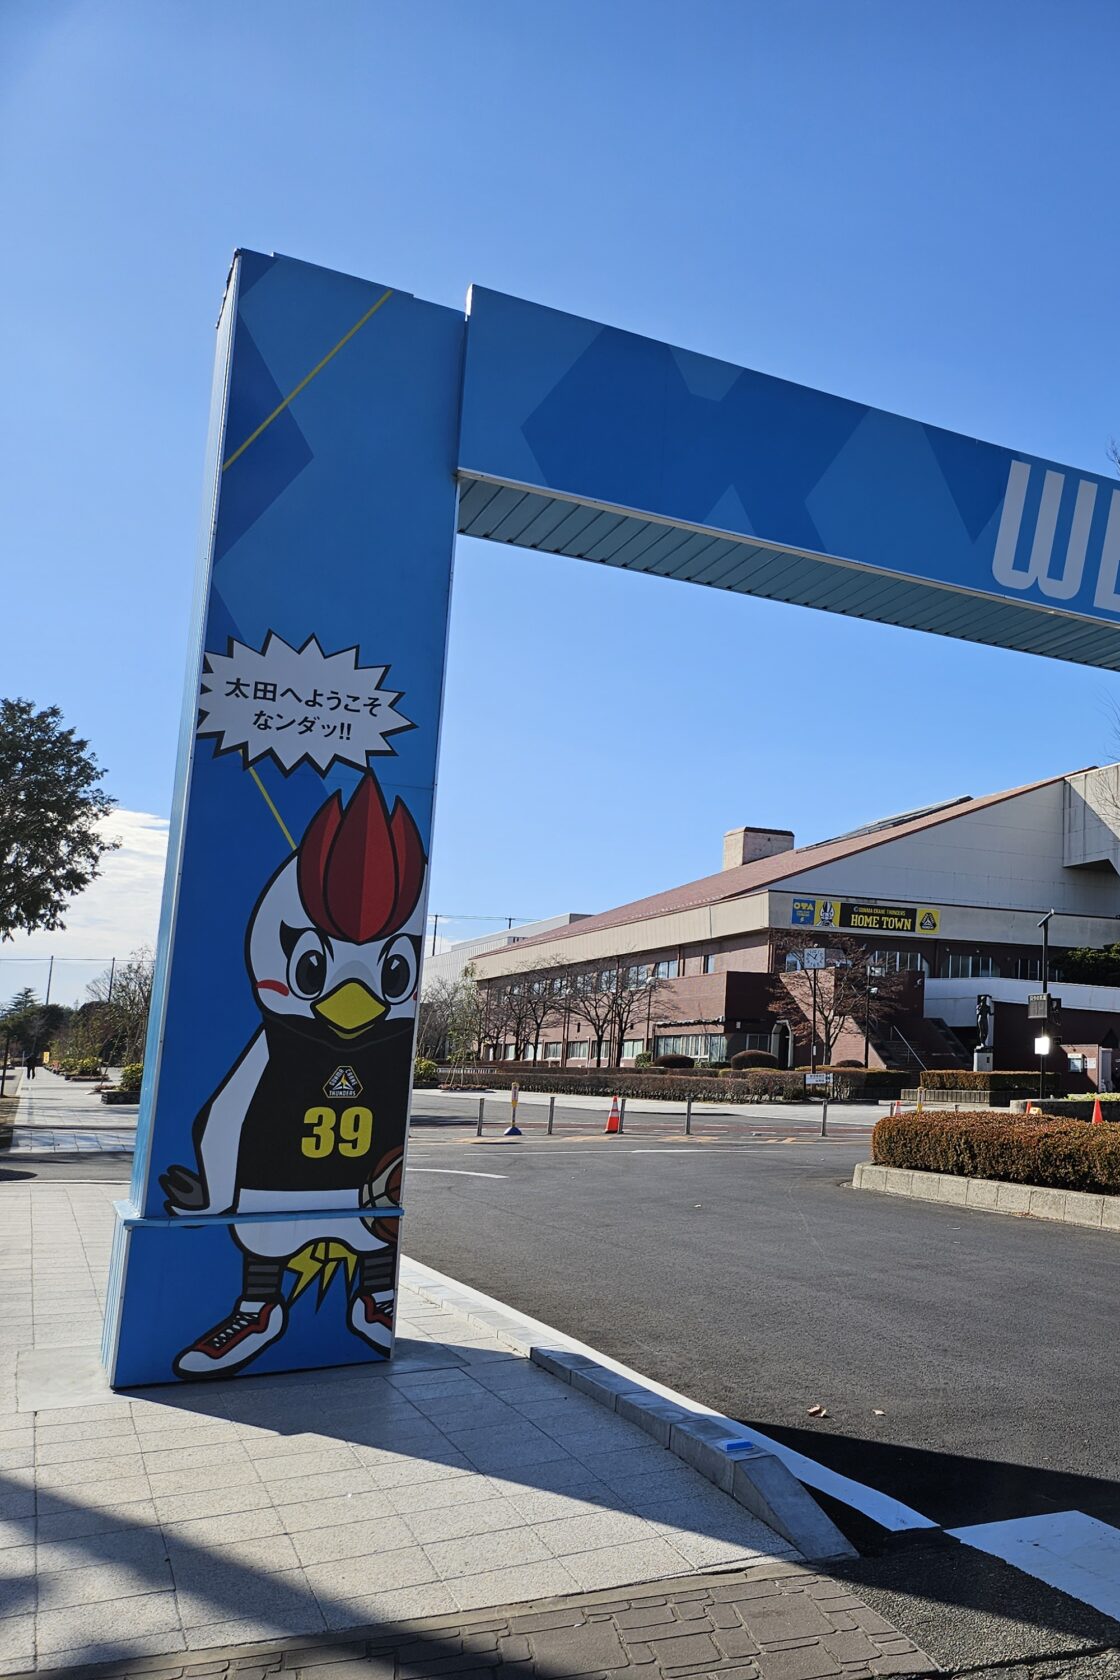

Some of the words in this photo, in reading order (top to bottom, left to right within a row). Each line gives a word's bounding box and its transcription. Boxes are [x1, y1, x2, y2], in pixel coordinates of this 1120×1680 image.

[224, 678, 382, 717] 太田へようこそ
[851, 914, 880, 928] HOME
[882, 917, 912, 930] TOWN
[301, 1106, 373, 1159] 39
